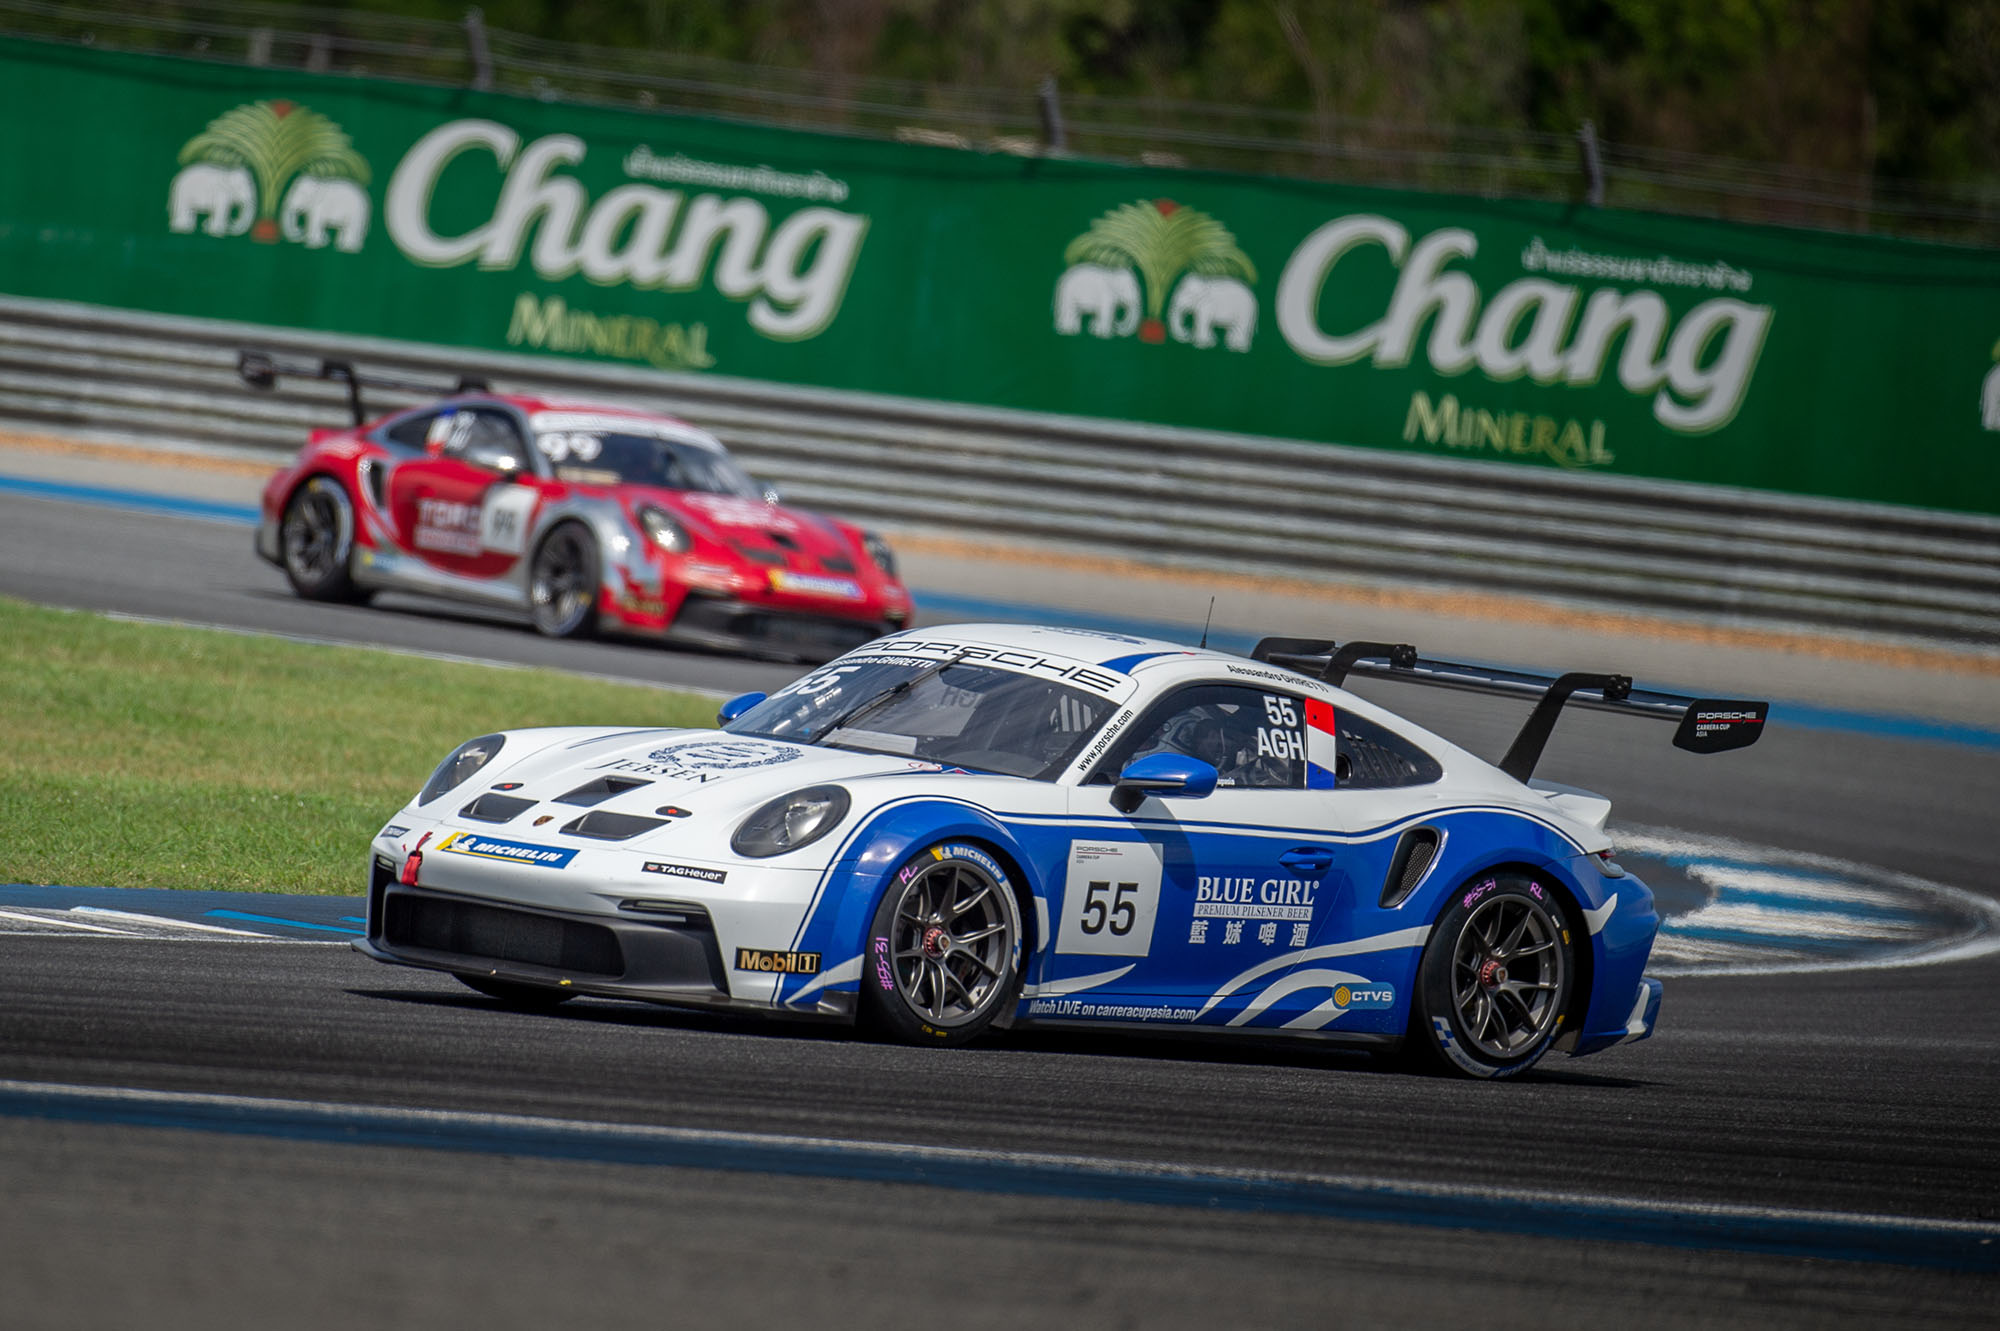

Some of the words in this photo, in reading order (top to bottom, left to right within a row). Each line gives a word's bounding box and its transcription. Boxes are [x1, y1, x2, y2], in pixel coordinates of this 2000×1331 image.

[384, 117, 870, 342] Chang
[1275, 213, 1775, 434] Chang
[1403, 391, 1616, 469] MINERAL
[857, 640, 1121, 692] PORSCHE
[876, 656, 937, 668] GHIRETTI
[772, 666, 861, 699] 55
[1263, 695, 1297, 727] 55
[1077, 709, 1134, 771] www.porsche.com
[1257, 727, 1305, 760] AGH
[584, 758, 722, 783] JEBSEN
[472, 842, 563, 862] MICHELIN
[953, 846, 1003, 879] MICHELIN
[899, 866, 918, 884] FL
[1196, 877, 1255, 902] BLUE
[1530, 882, 1543, 900] RL
[1081, 881, 1139, 936] 55
[1198, 905, 1240, 916] PREMIUM
[1242, 906, 1284, 917] PILSENER
[1286, 908, 1309, 918] BEER
[740, 951, 796, 972] Mobil
[1352, 991, 1392, 1001] CTVS
[1029, 999, 1056, 1014] Watch
[1056, 1001, 1082, 1015] LIVE
[1081, 1004, 1096, 1015] on
[1096, 1005, 1197, 1022] carreracupasia.com
